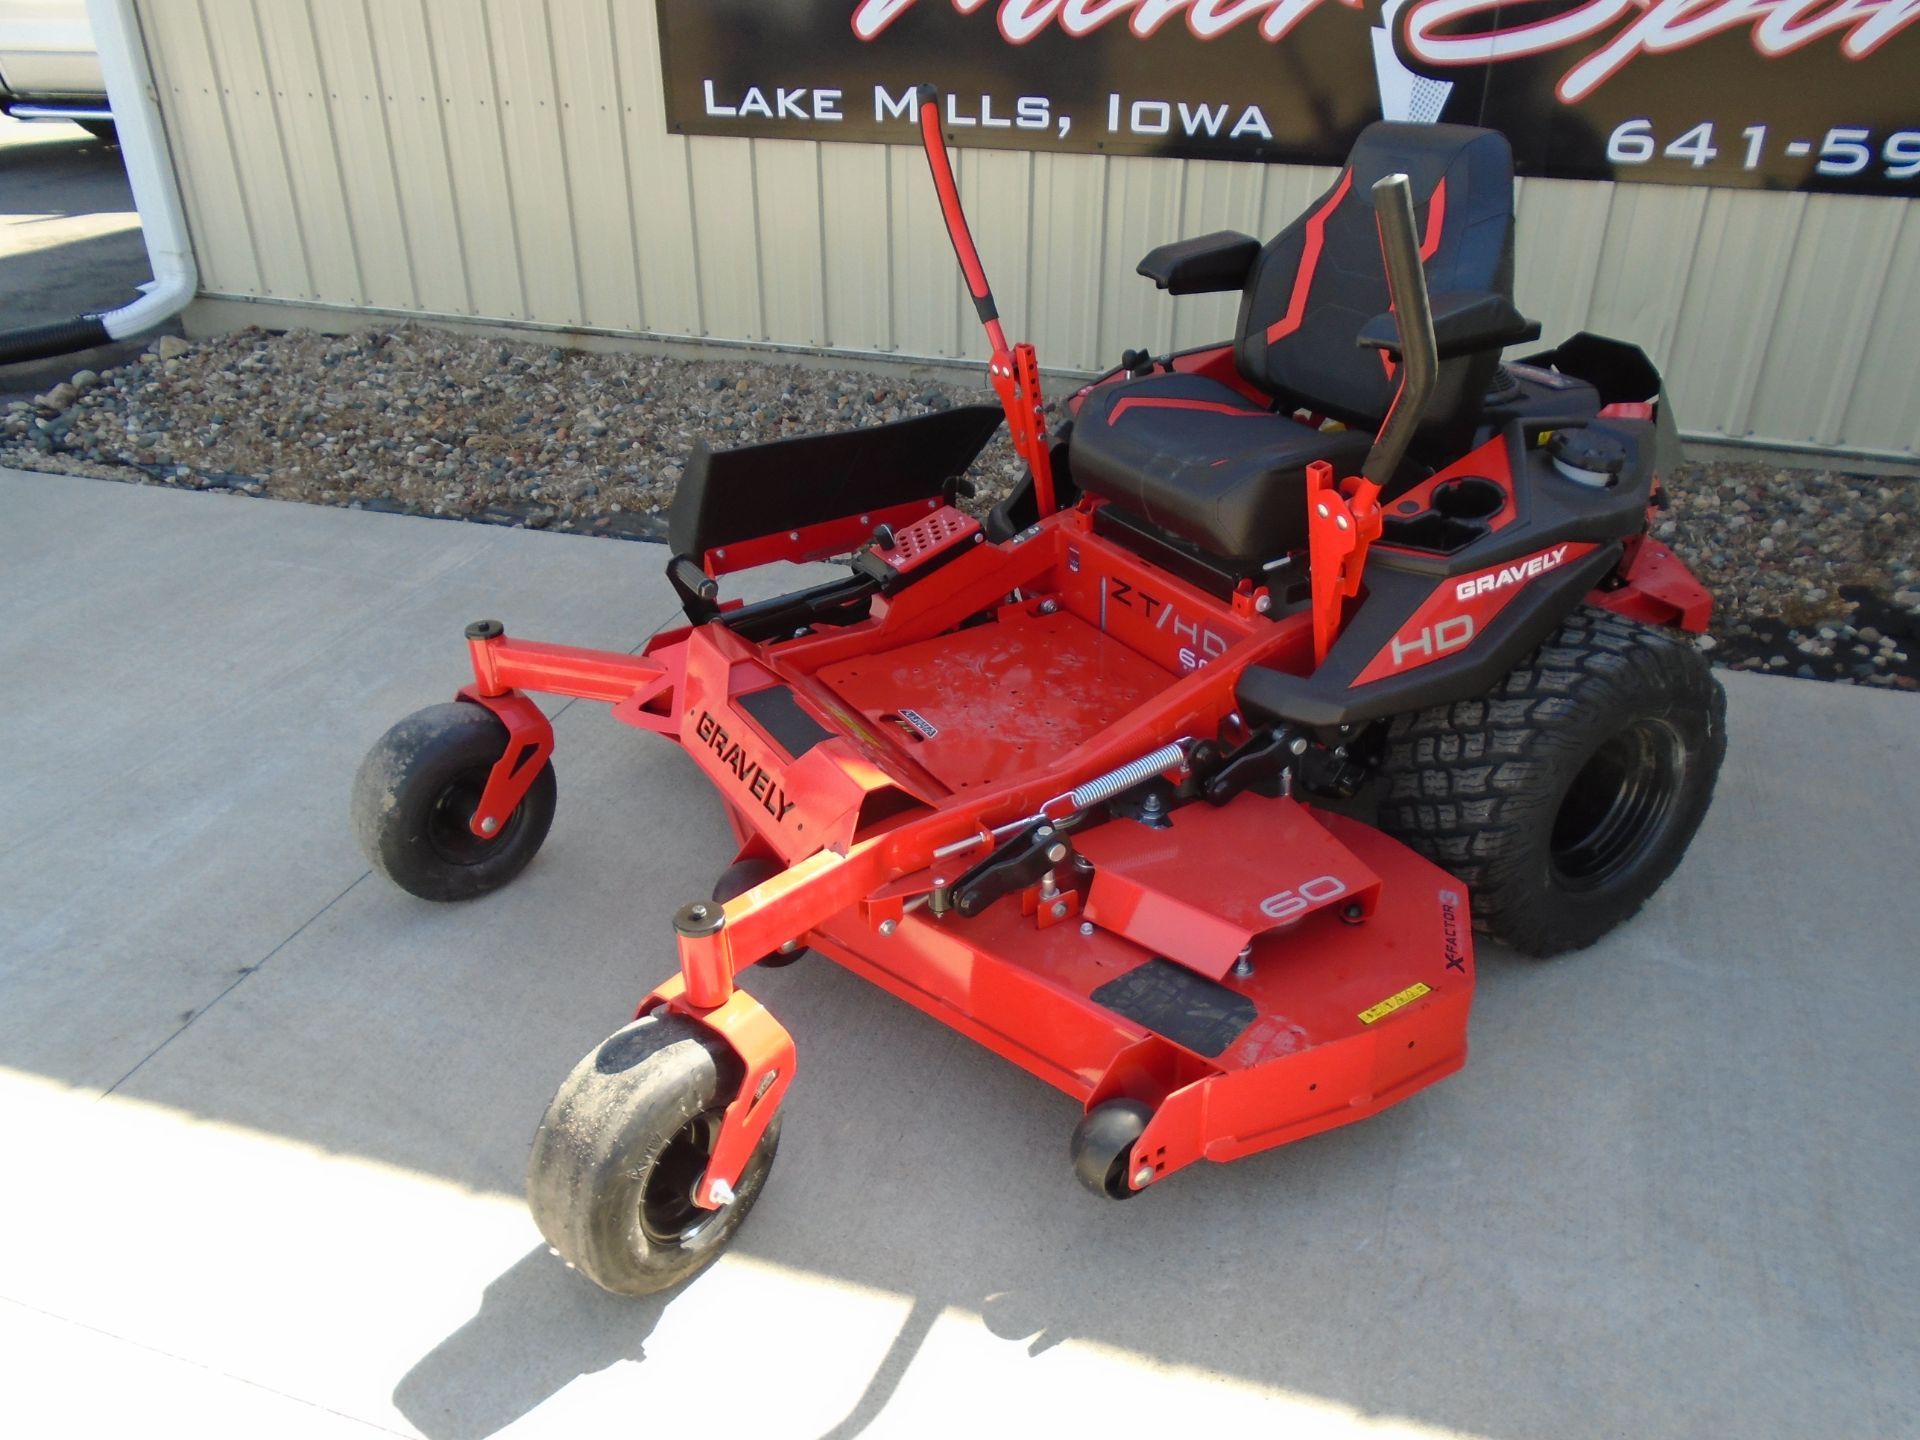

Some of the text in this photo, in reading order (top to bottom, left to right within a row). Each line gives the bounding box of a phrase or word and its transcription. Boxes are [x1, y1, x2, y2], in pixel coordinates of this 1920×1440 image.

[703, 80, 1273, 140] LAKE MLLS, IOWA
[1456, 545, 1568, 601] GRAVELY
[1391, 614, 1475, 665] HD
[695, 711, 796, 823] GRAVELY
[1260, 875, 1346, 919] 60
